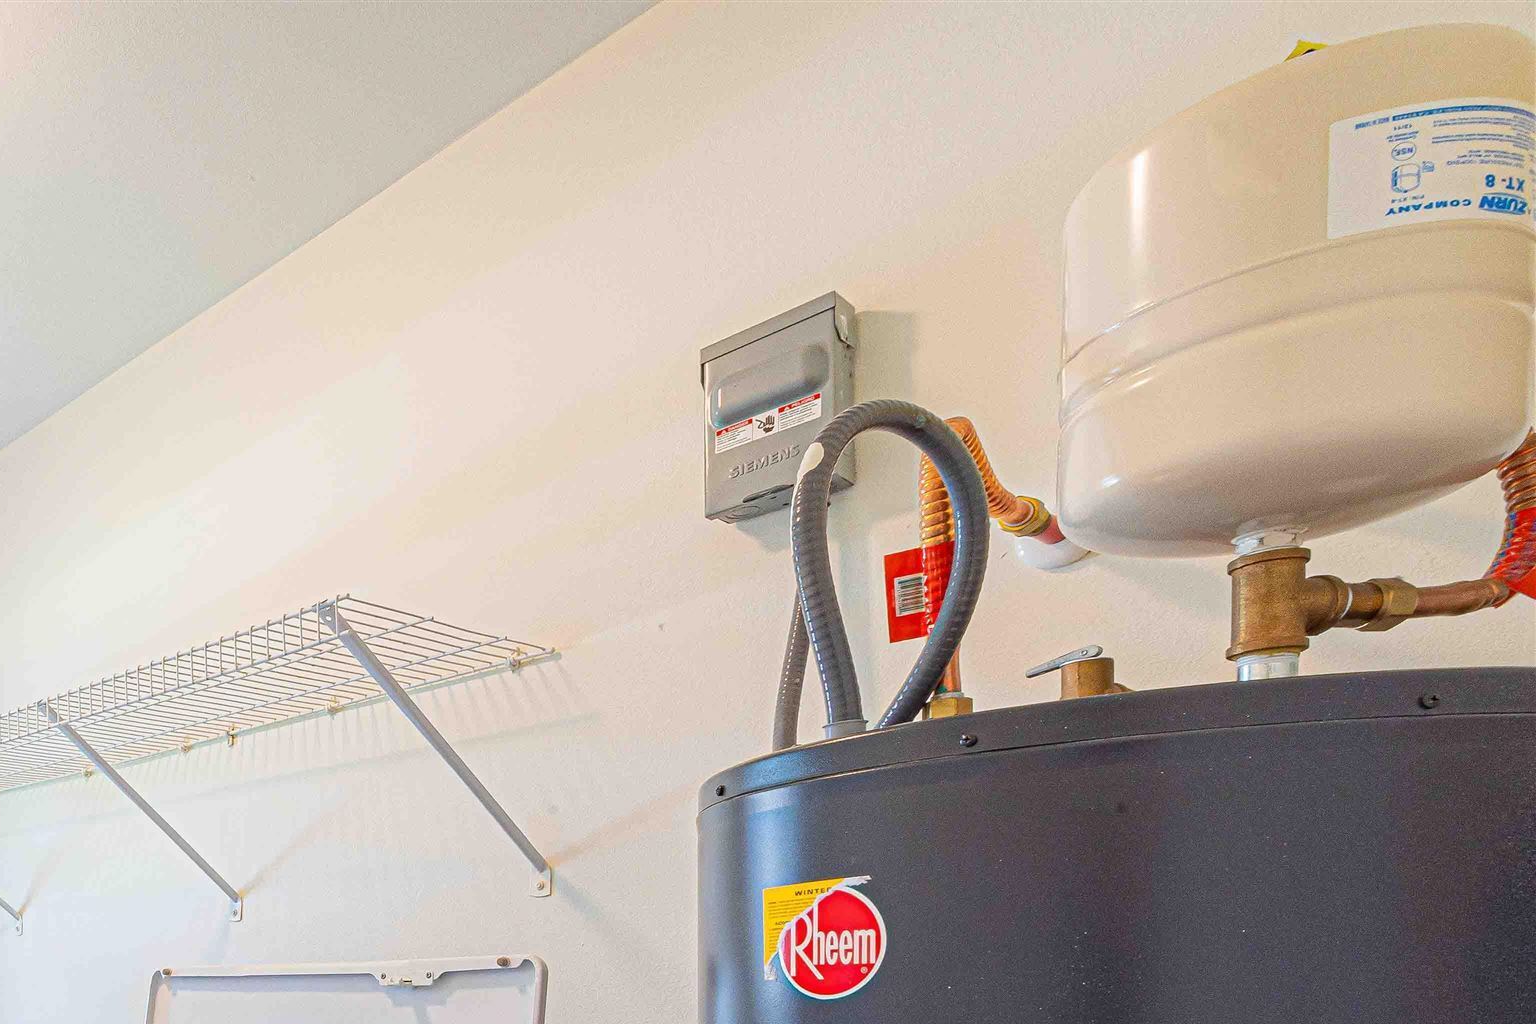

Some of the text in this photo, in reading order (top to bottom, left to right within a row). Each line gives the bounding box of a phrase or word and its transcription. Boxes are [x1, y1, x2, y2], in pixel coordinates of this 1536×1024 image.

[1384, 198, 1472, 217] COMPANY
[1478, 195, 1529, 214] ZURN
[728, 443, 801, 479] SIEMENS
[789, 904, 878, 981] Rheem
